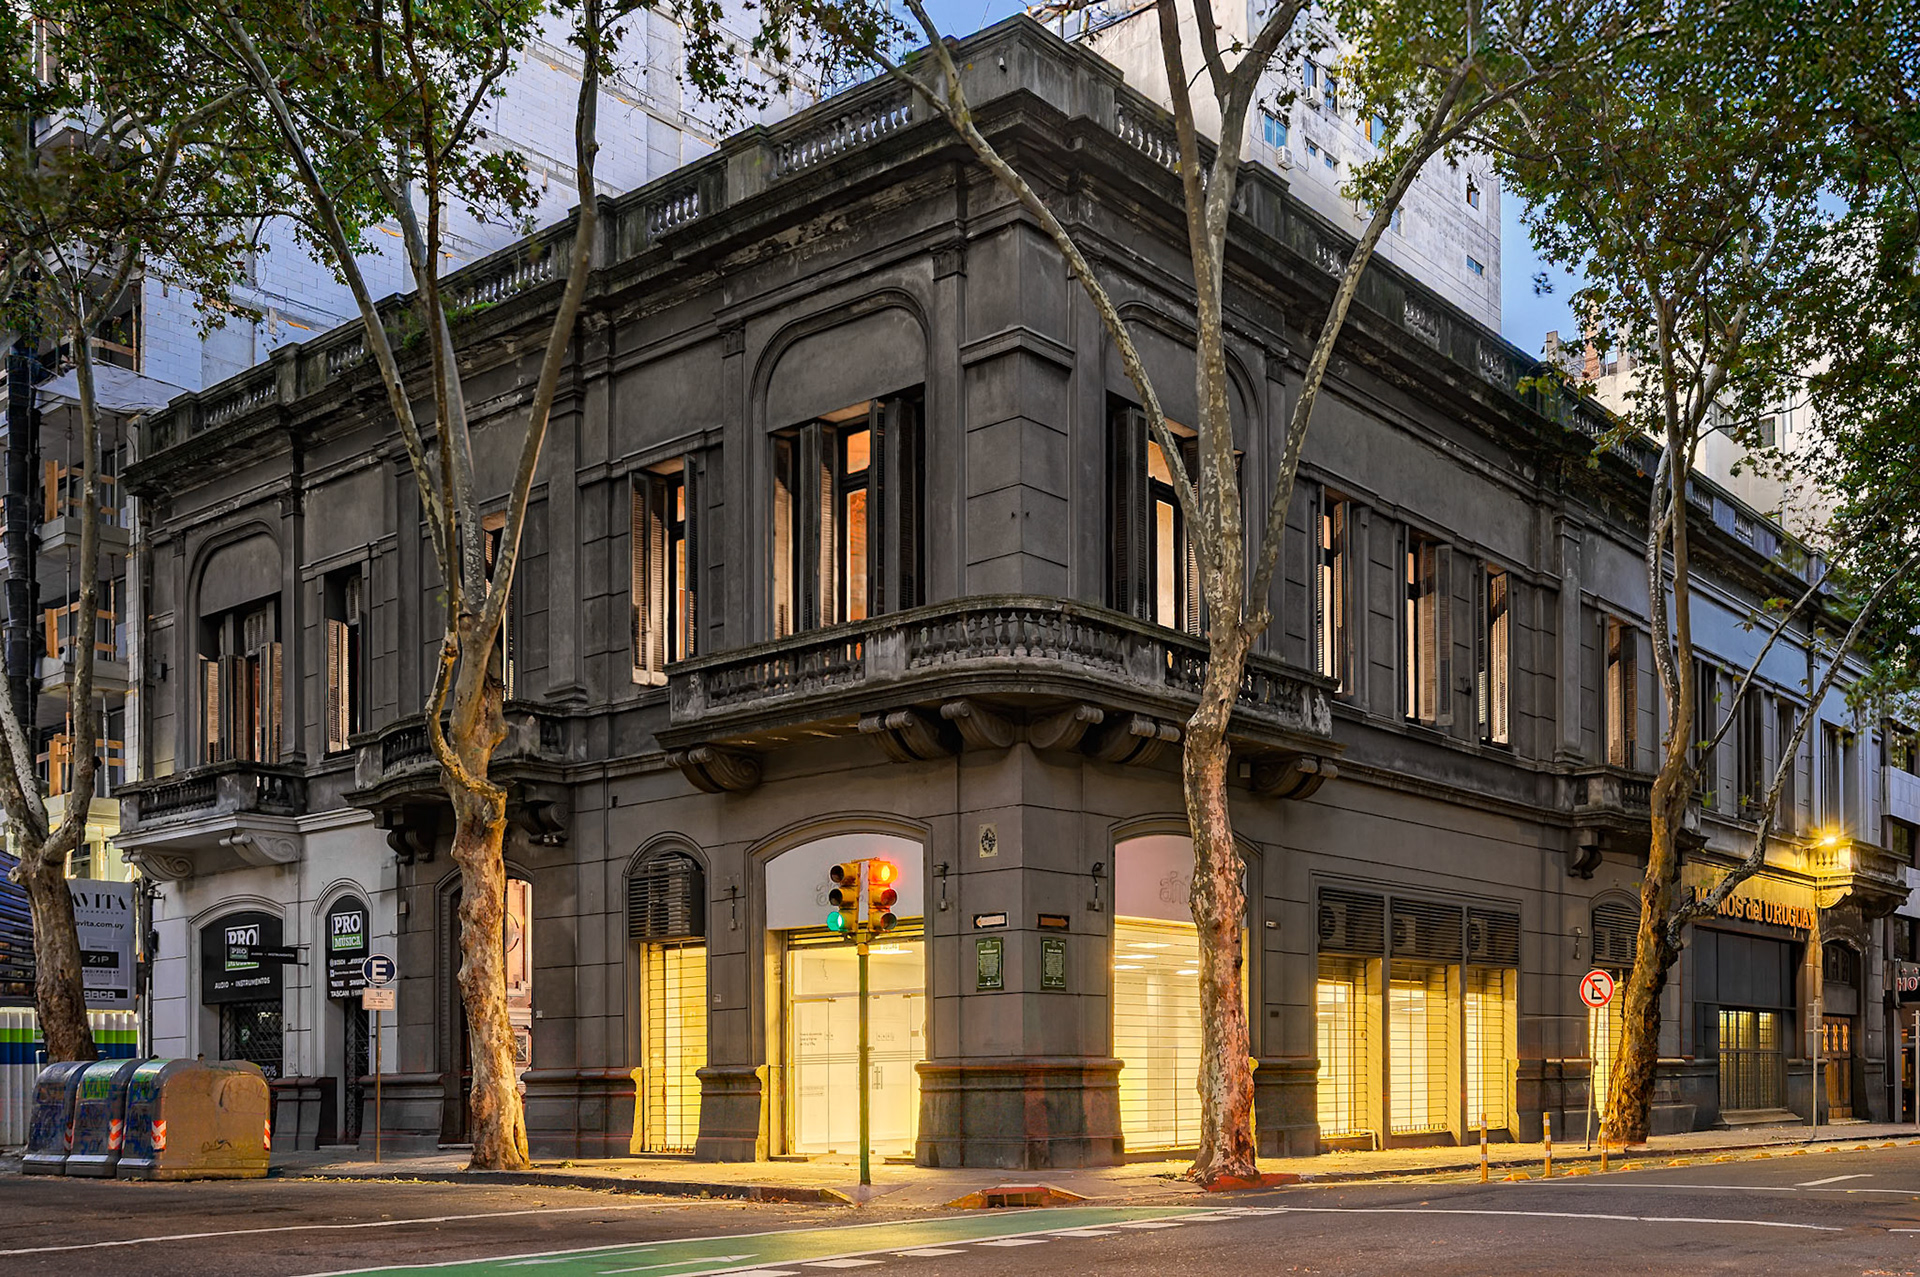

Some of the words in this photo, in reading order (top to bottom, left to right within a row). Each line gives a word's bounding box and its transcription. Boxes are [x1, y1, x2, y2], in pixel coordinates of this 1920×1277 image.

[333, 914, 361, 935] PRO
[1746, 900, 1763, 922] del
[1764, 900, 1817, 931] URUGUAY
[227, 928, 257, 946] PRO
[334, 934, 361, 948] MÚSICA
[371, 959, 388, 980] E
[214, 981, 230, 989] AUDIO
[235, 977, 271, 988] INSTRUMENTOS
